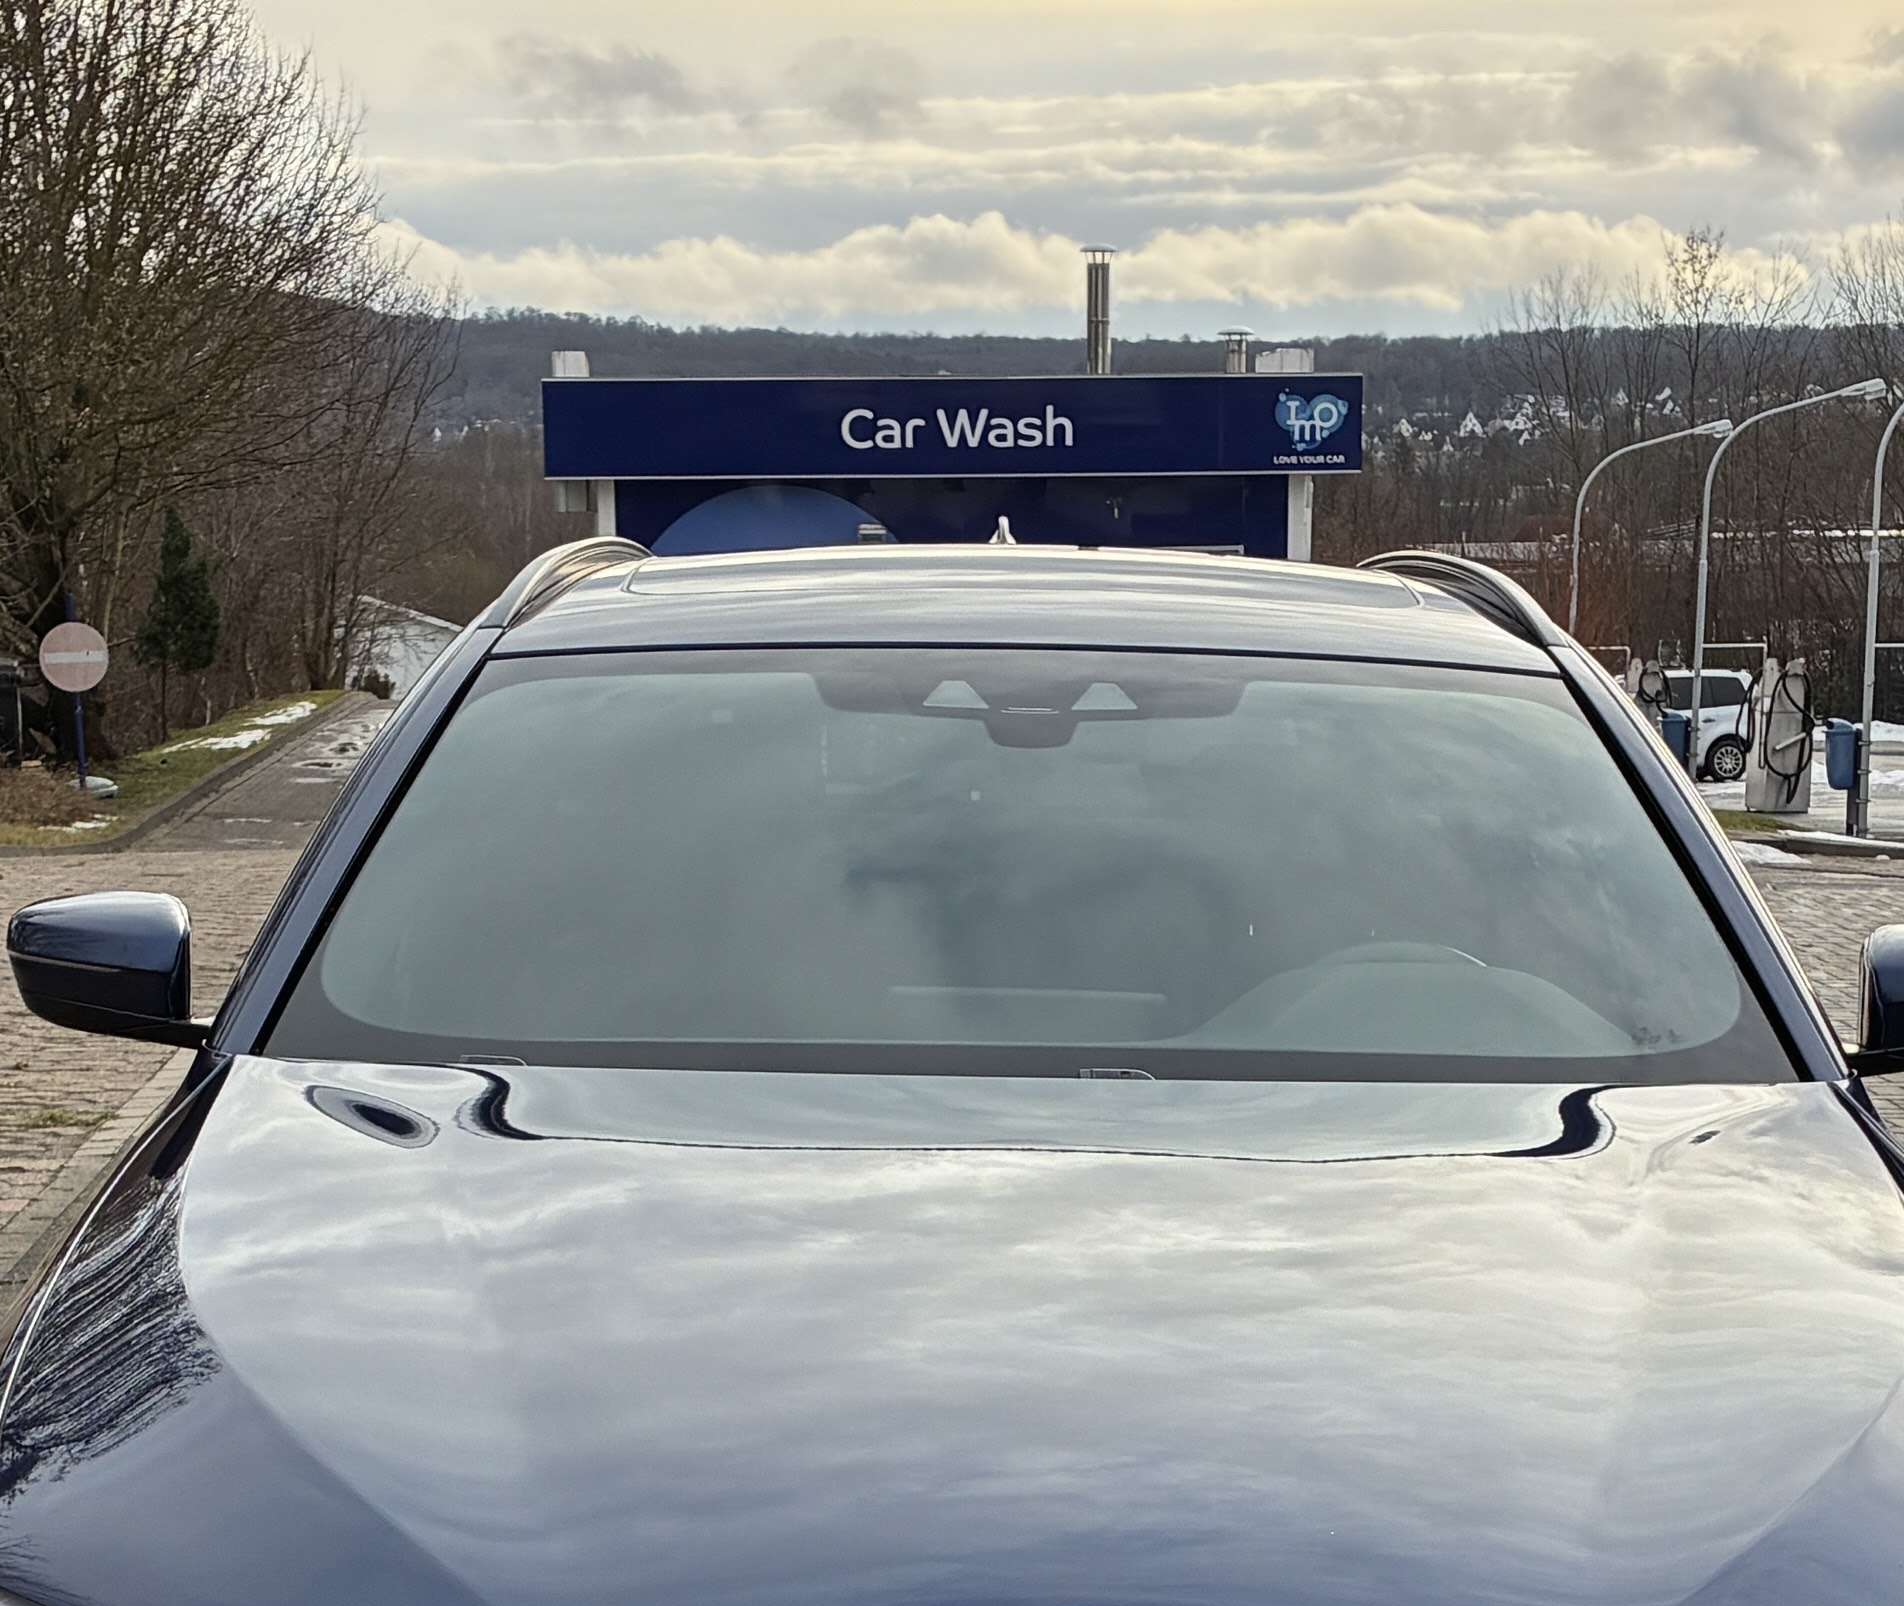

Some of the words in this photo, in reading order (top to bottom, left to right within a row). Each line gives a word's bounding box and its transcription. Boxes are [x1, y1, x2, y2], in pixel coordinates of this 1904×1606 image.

[840, 408, 926, 451] Car
[935, 403, 1075, 450] Wash
[1273, 455, 1298, 464] LOVE
[1299, 455, 1325, 464] YOUR
[1326, 454, 1346, 464] CAR
